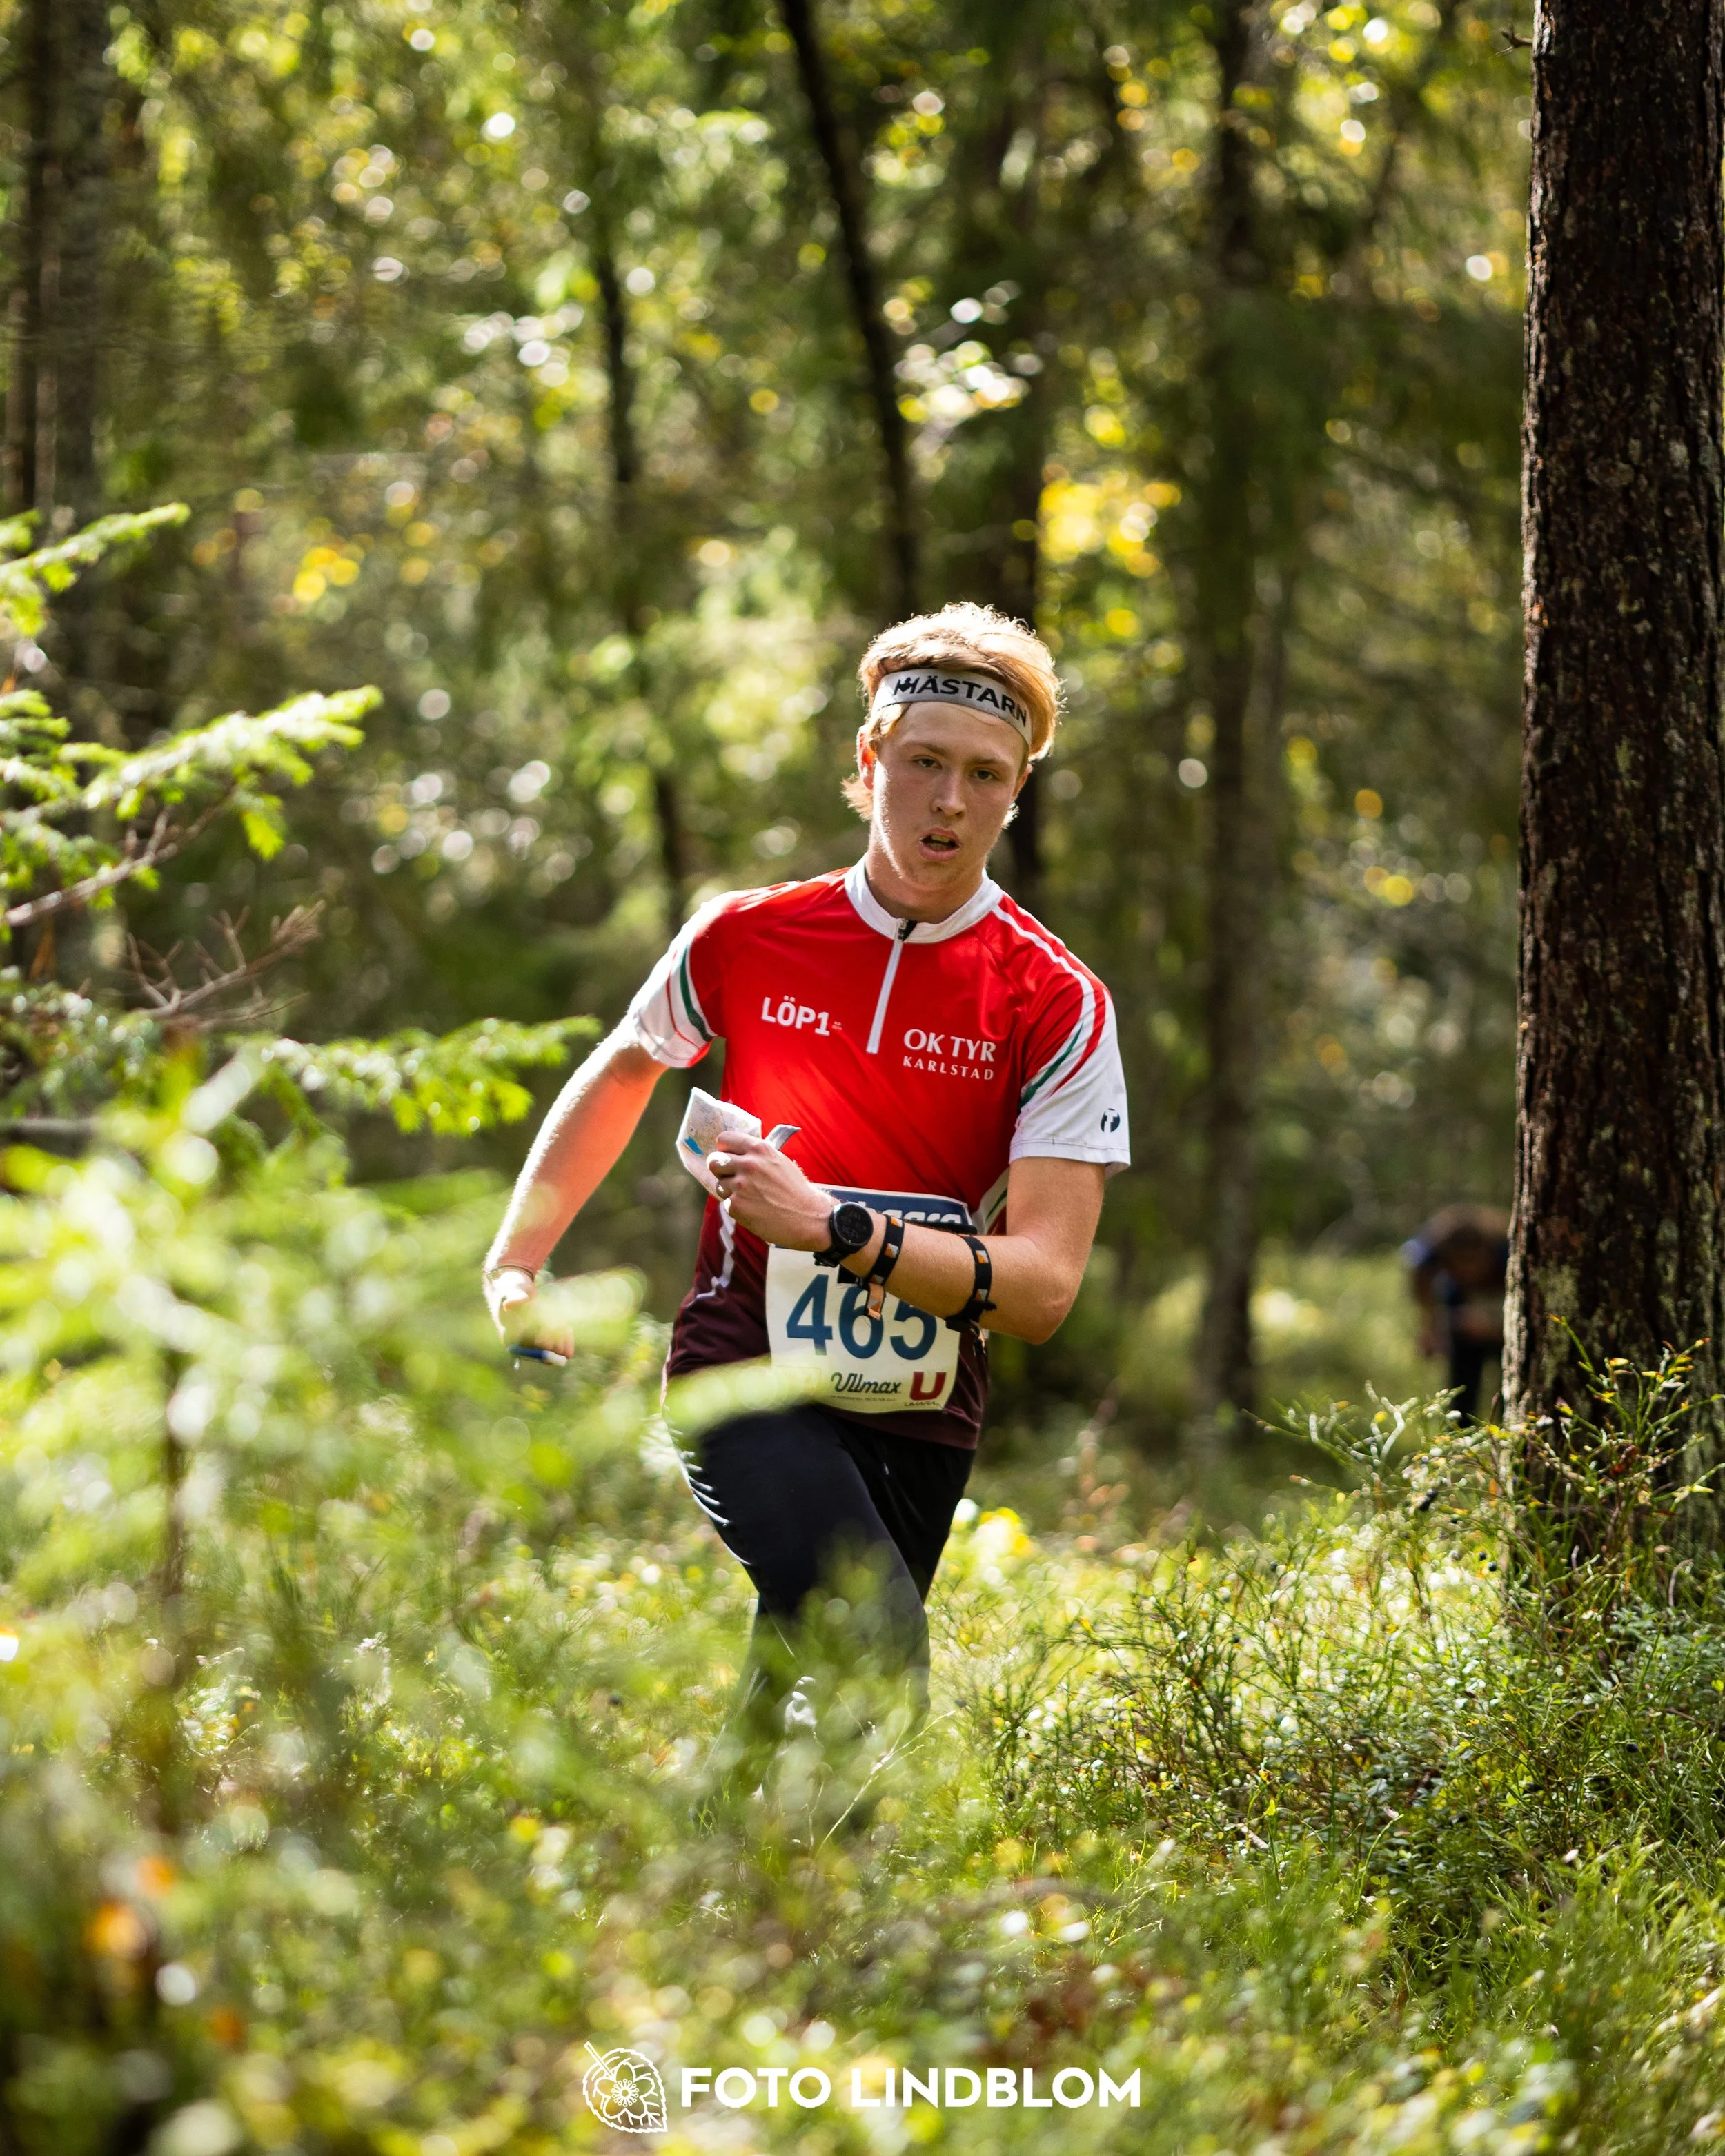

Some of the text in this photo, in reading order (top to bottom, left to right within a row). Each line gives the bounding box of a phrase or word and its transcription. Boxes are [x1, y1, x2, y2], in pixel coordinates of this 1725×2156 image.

[761, 995, 830, 1036] LÖP1
[903, 1028, 996, 1062] OK TYR
[903, 1055, 994, 1081] KARLSTAD
[785, 1274, 937, 1361] 465
[909, 1370, 947, 1401] U
